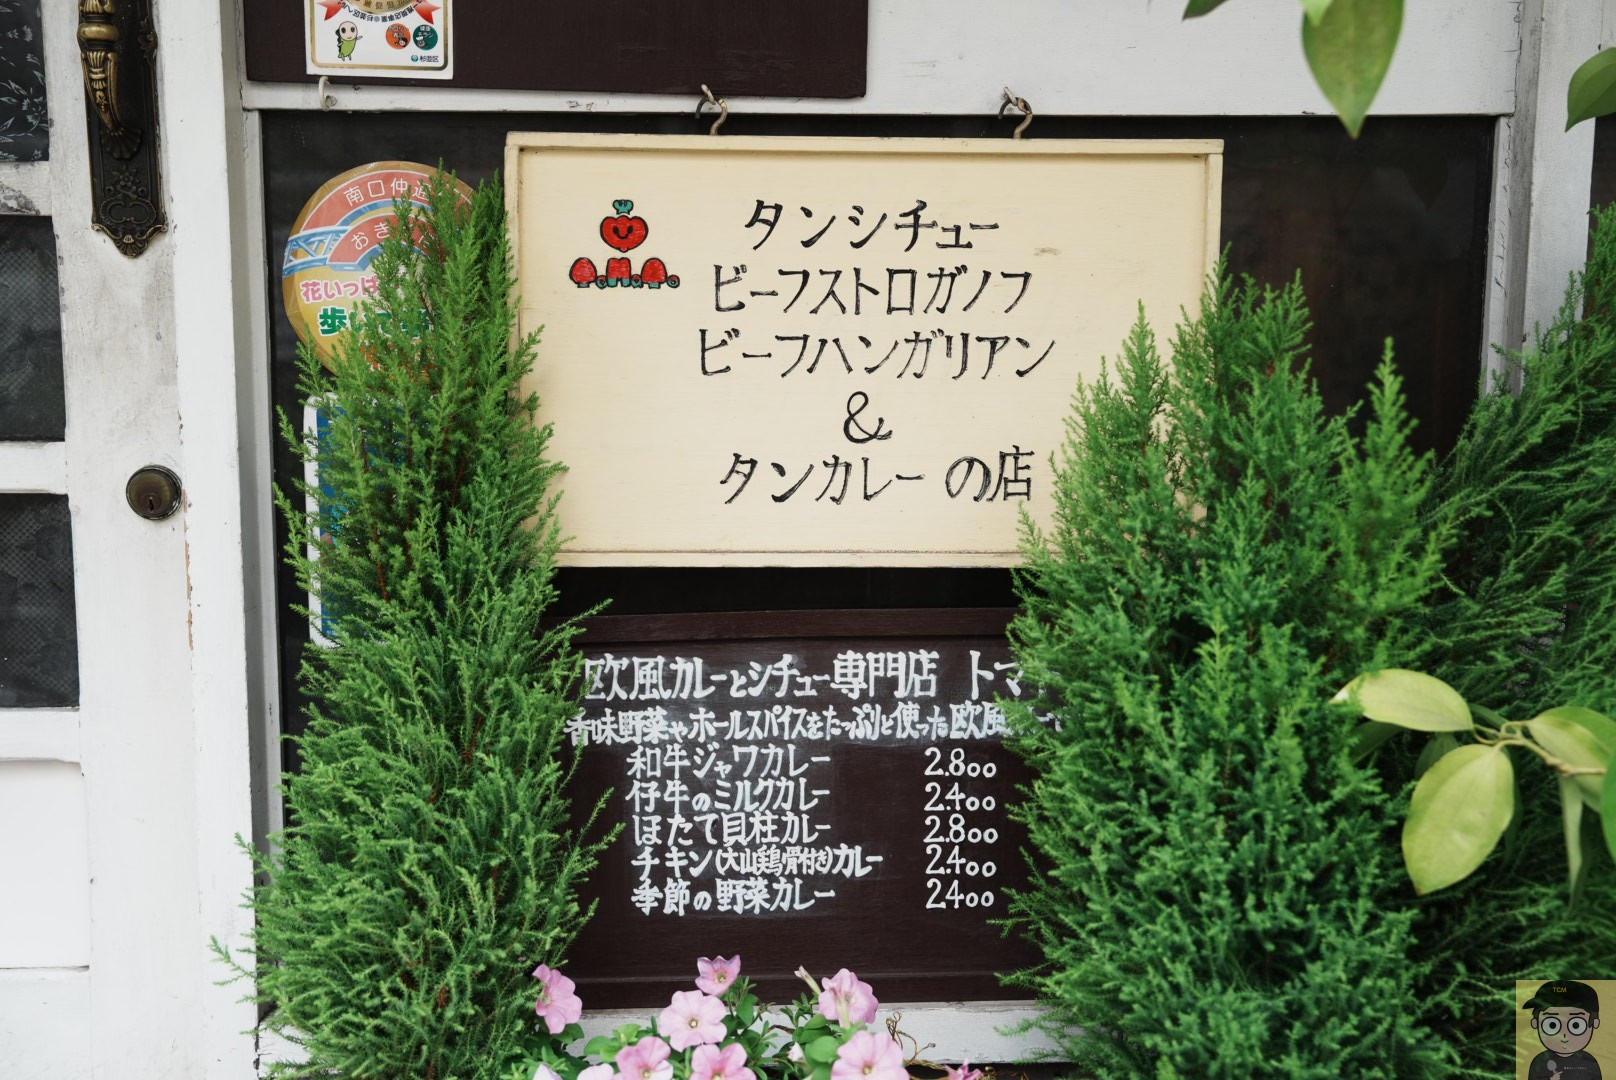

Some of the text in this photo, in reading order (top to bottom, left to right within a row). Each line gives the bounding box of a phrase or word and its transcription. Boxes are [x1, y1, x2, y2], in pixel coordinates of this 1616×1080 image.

[744, 199, 999, 252] タンシチュー
[713, 264, 1032, 316] ビーフストロガノフ
[699, 328, 1055, 380] ビーフハンガリアン
[843, 391, 893, 444] &
[585, 649, 1025, 701] 欧風カレーとシチュー専門店 トマ
[626, 743, 831, 779] 和牛ジャワカレー
[625, 777, 830, 813] 仔牛のミルクカレー
[632, 811, 831, 846] ほたて貝柱カレー
[631, 877, 835, 916] 季節の野菜カレー
